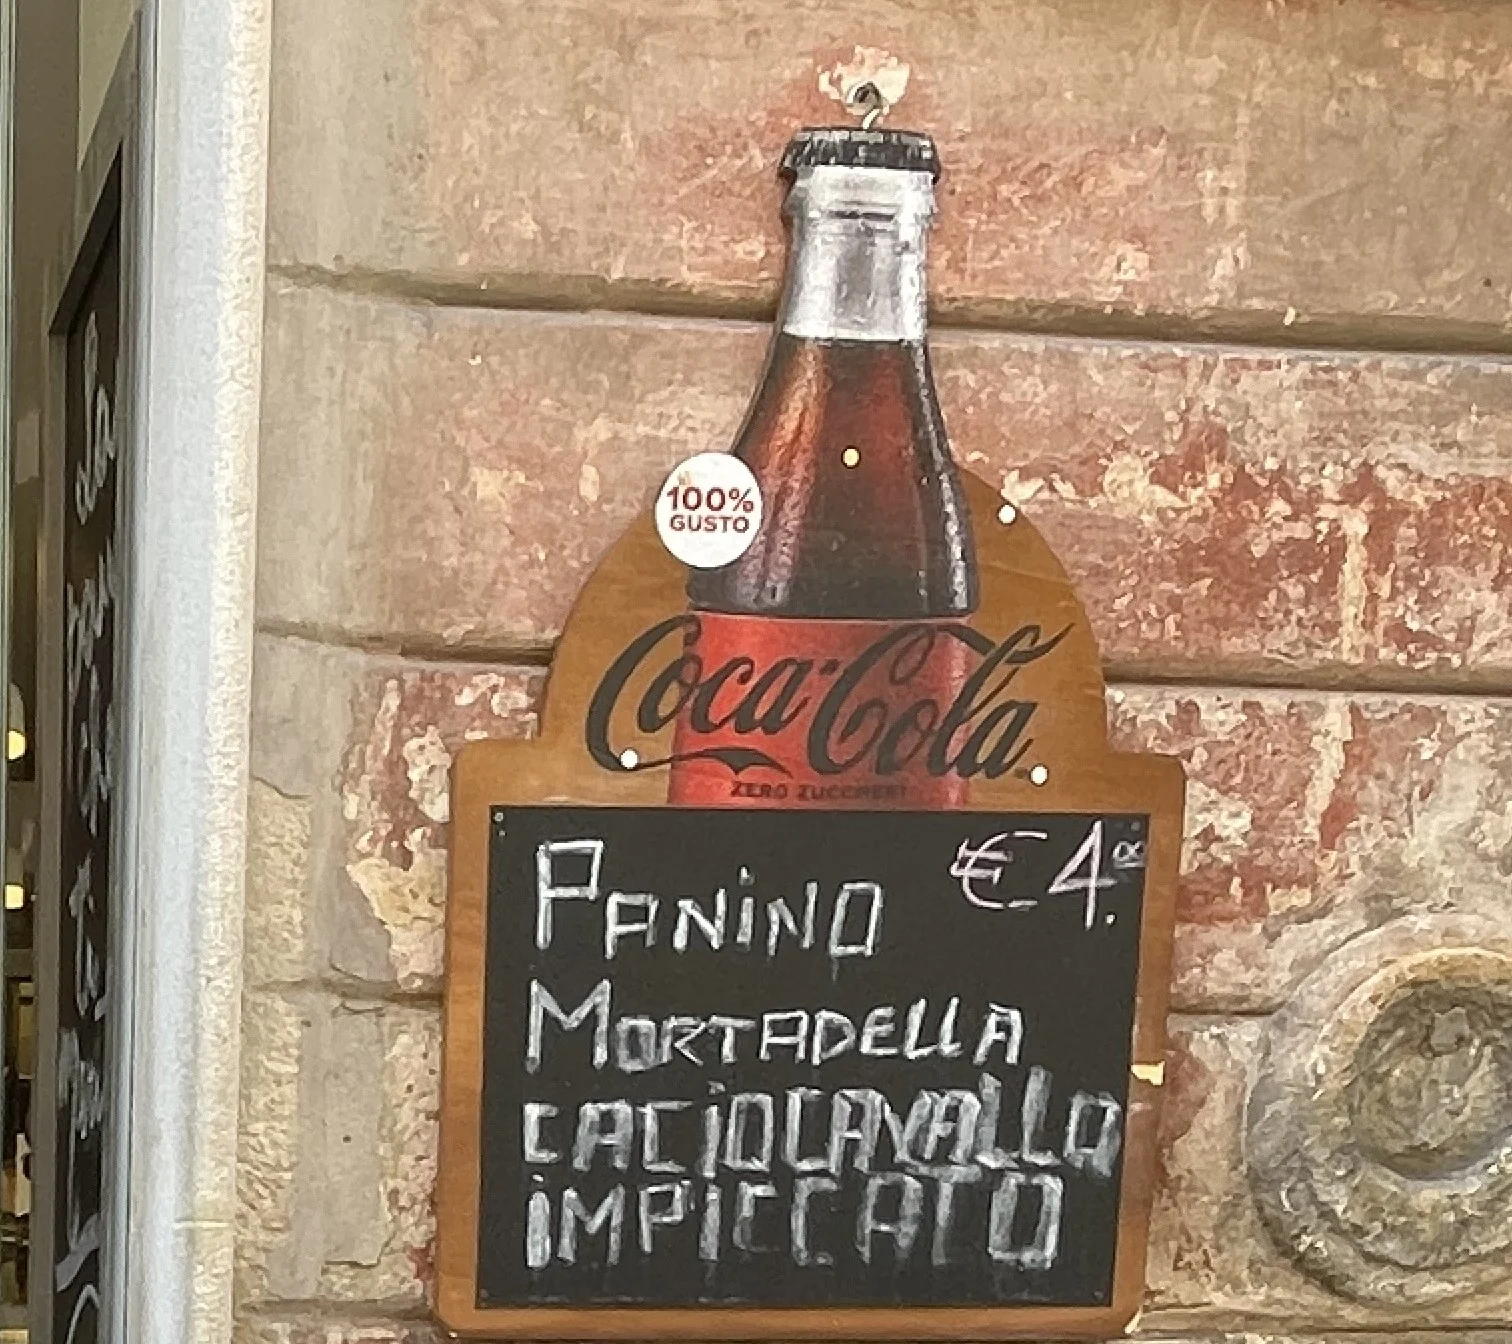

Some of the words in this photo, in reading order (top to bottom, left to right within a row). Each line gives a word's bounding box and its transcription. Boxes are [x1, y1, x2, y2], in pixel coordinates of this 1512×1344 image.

[667, 486, 754, 513] 100%
[670, 514, 750, 533] GUSTO
[585, 613, 1076, 781] Coca-Cola
[731, 781, 788, 798] ZERO
